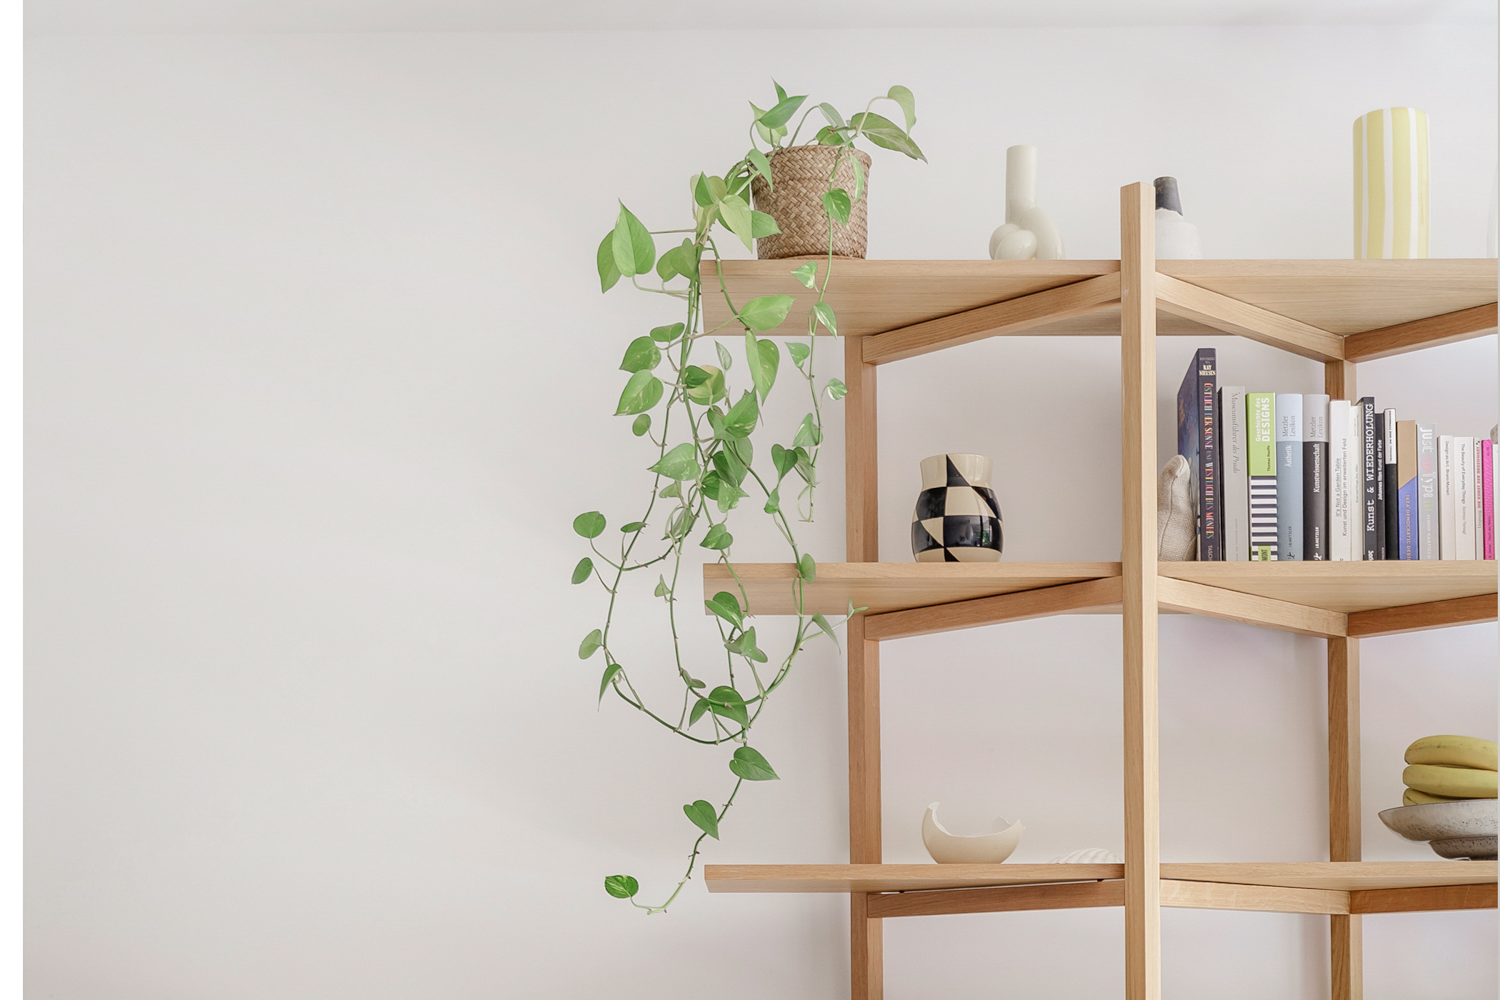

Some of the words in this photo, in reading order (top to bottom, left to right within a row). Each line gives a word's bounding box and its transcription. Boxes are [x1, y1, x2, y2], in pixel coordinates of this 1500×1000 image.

[1204, 382, 1213, 411] ÖSTLICH
[1230, 392, 1240, 443] Museumsführer
[1261, 397, 1271, 442] DESIGNS
[1204, 427, 1213, 450] SONNE
[1232, 444, 1240, 455] des
[1365, 403, 1374, 481] WIEDERHOLUNG
[1232, 455, 1240, 474] Prado
[1284, 444, 1293, 468] Ästhetik
[1313, 443, 1321, 493] Kunstwissenschaft
[1420, 456, 1433, 472] My
[1204, 462, 1214, 496] WESTLICH
[1366, 486, 1374, 494] &
[1421, 471, 1436, 498] Type
[1205, 497, 1214, 510] DES
[1366, 499, 1375, 532] Kunst
